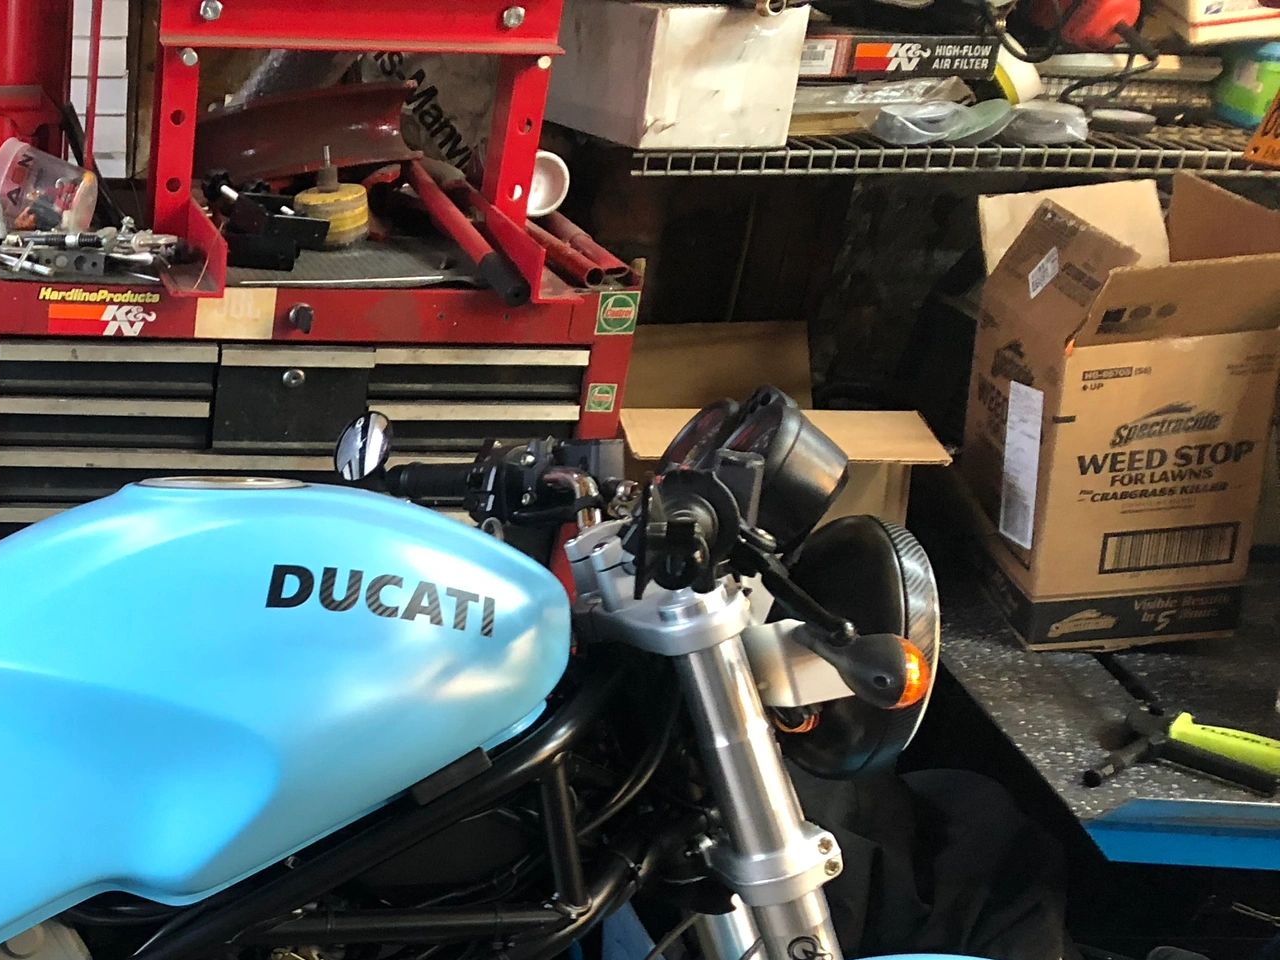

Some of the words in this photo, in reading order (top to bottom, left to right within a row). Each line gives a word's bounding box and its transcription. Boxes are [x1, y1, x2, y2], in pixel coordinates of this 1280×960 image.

[885, 43, 932, 72] K&N
[934, 44, 992, 57] HIGH-FLOW
[932, 57, 951, 69] AIR
[952, 57, 989, 70] FILTER
[100, 304, 157, 337] K&N
[1077, 449, 1168, 476] WEED
[1173, 441, 1255, 468] STOP
[1110, 473, 1147, 488] FOR
[1149, 466, 1214, 486] LAWNS
[1090, 487, 1177, 503] CRABGRASS
[265, 564, 496, 638] DUCATI
